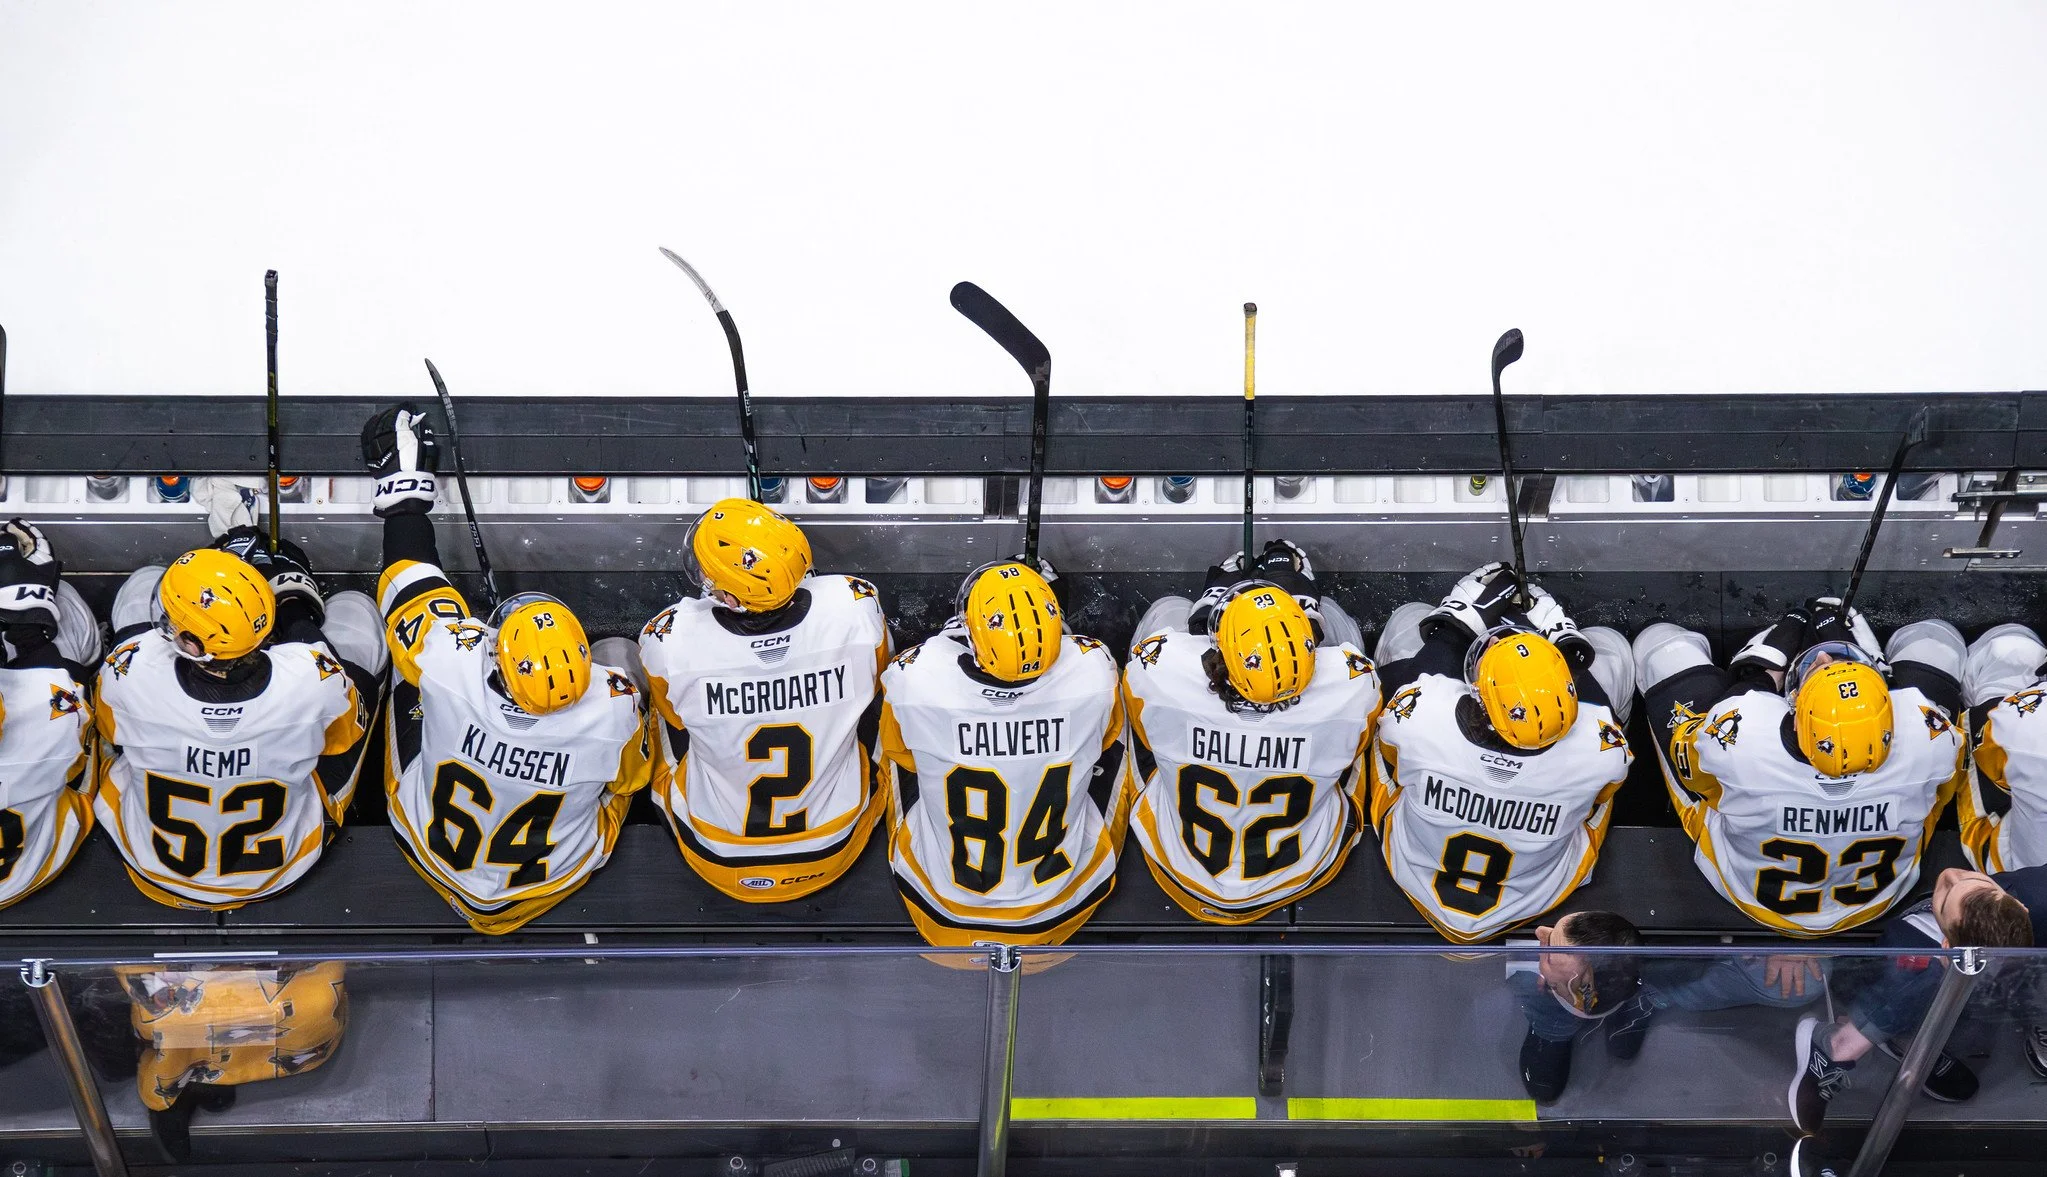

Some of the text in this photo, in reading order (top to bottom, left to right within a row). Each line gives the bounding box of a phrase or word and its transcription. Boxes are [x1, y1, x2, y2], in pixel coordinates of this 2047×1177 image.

[375, 478, 435, 497] CCM
[468, 521, 482, 548] CCM
[999, 567, 1020, 579] 84
[253, 613, 268, 634] 52
[1786, 613, 1807, 623] CCM
[1816, 616, 1836, 630] CCM
[750, 634, 791, 649] CCM
[1021, 660, 1040, 674] 84
[706, 664, 846, 715] McGROARTY
[981, 688, 1023, 699] CCM
[1838, 681, 1859, 699] 23
[200, 706, 243, 716] CCM
[957, 717, 1065, 757] CALVERT
[1192, 727, 1306, 769] GALLANT
[186, 746, 251, 778] KEMP
[462, 724, 571, 787] KLASSEN
[1479, 753, 1523, 769] CCM
[743, 722, 814, 838] 2
[1424, 775, 1561, 835] McDONOUGH
[1783, 802, 1890, 835] RENWICK
[146, 770, 288, 878] 52
[425, 759, 567, 889] 64
[944, 761, 1074, 895] 84
[1176, 763, 1317, 881] 62
[780, 872, 825, 885] CCM
[1431, 830, 1516, 919] 8
[1754, 835, 1908, 916] 23
